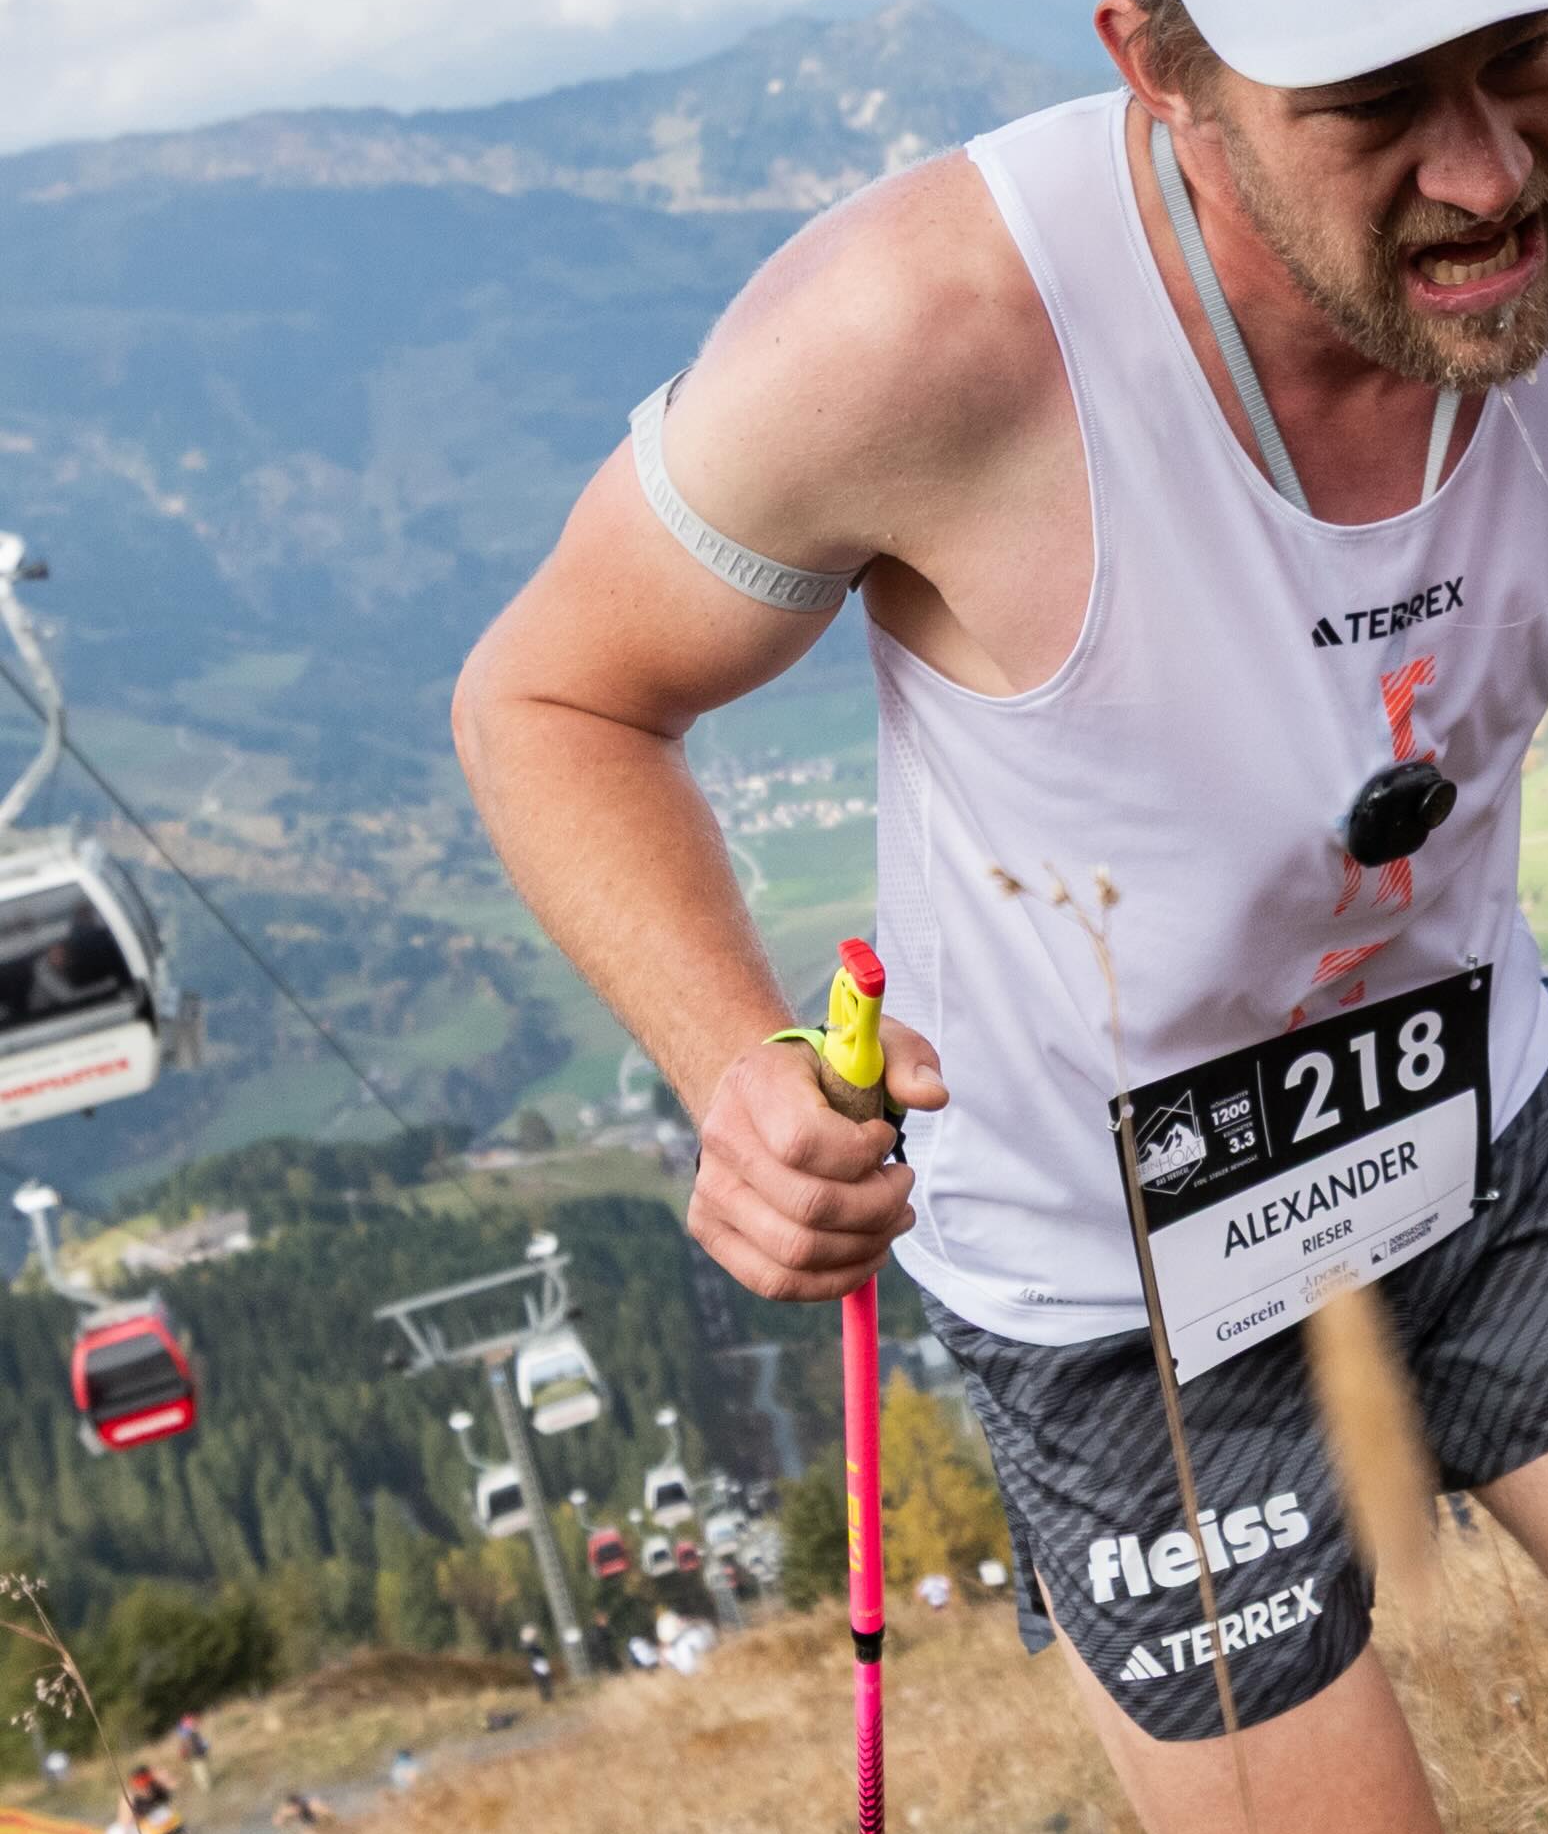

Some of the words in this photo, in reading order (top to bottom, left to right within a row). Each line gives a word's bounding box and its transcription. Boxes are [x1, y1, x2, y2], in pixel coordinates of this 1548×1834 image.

[1344, 576, 1465, 644] TERREX
[1284, 1010, 1446, 1144] 218
[1211, 1099, 1250, 1126] 1200
[1229, 1131, 1255, 1153] 3.3
[1223, 1141, 1420, 1259] ALEXANDER
[1302, 1219, 1353, 1255] RIESER
[1305, 1269, 1360, 1304] GASIN
[1216, 1298, 1286, 1343] Gastein
[1088, 1492, 1310, 1604] fleiss
[1161, 1577, 1323, 1673] TERREX
